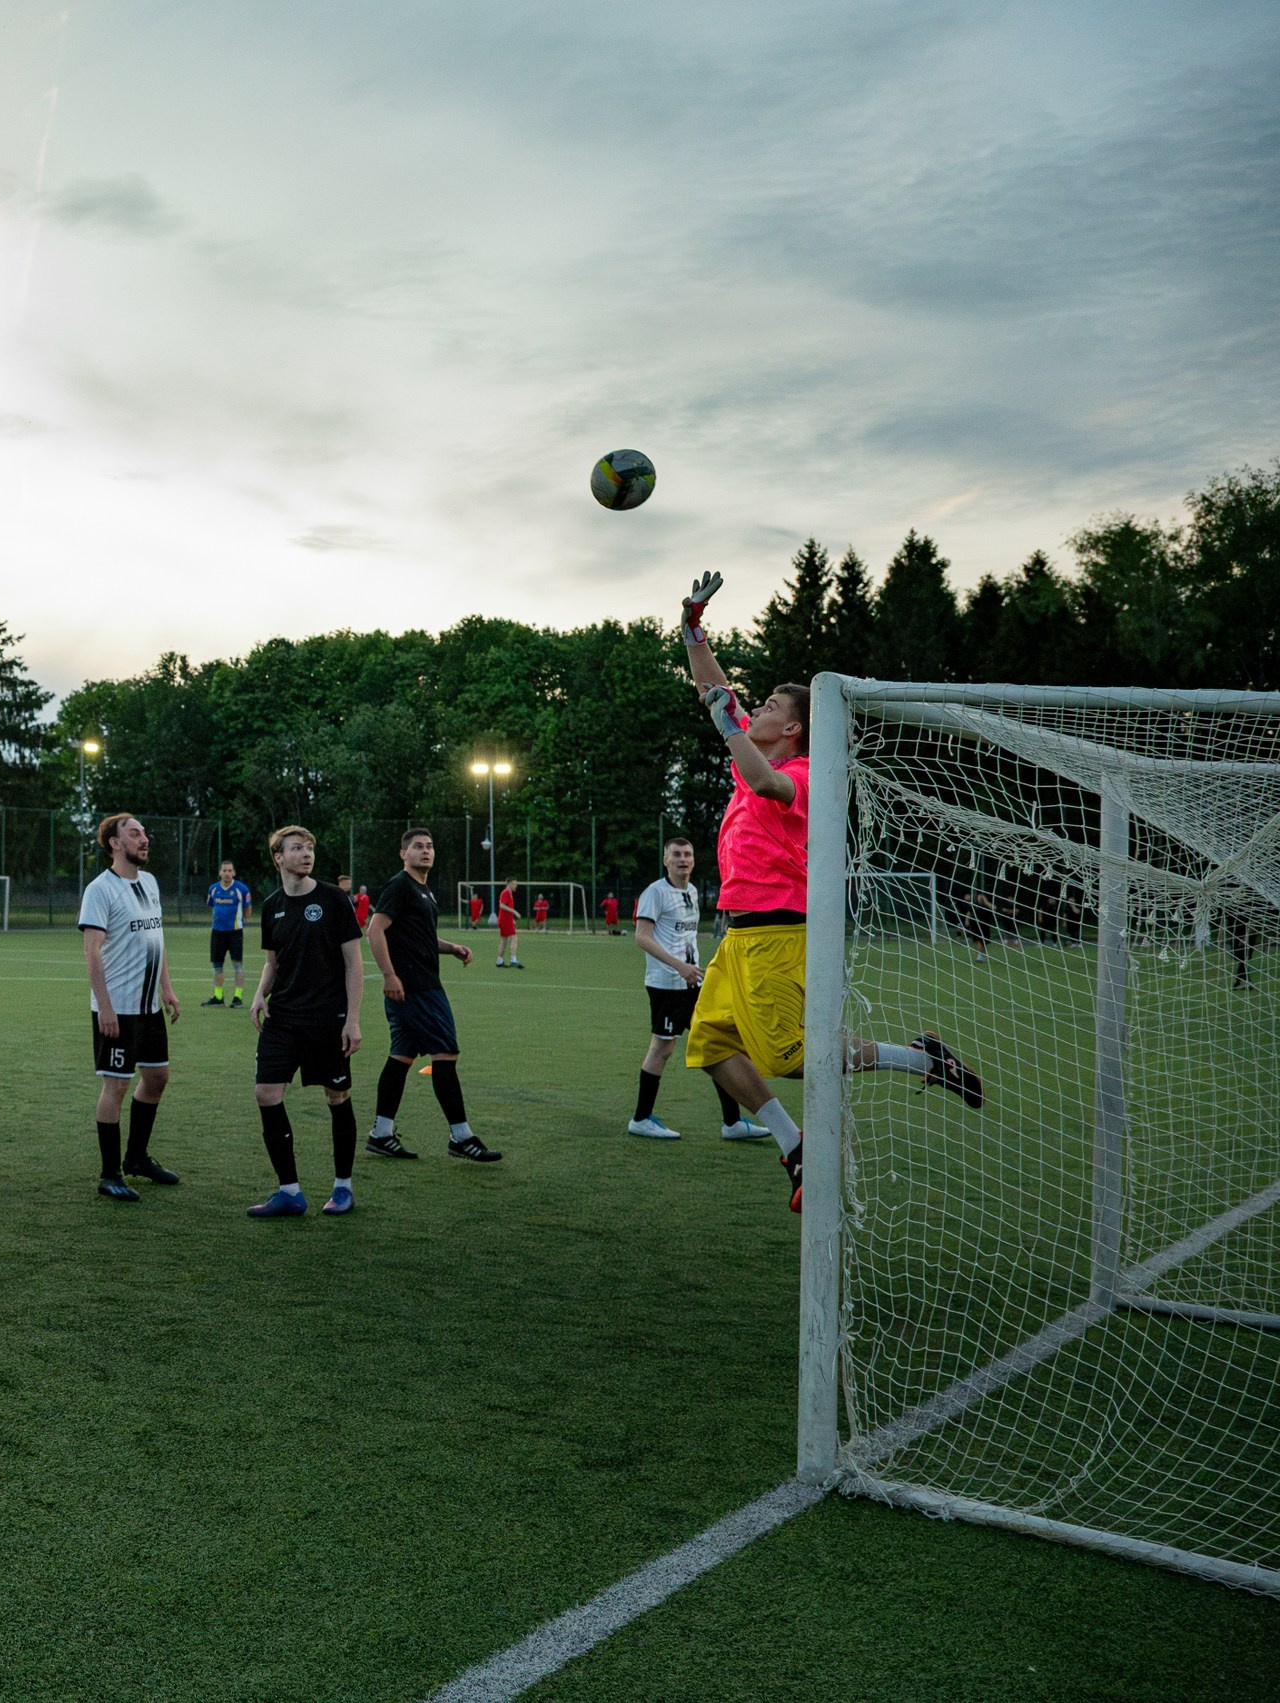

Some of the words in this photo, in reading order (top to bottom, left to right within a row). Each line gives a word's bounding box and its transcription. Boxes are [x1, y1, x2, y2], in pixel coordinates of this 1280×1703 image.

[130, 917, 163, 932] ЕРШОВ
[664, 1016, 673, 1033] 4
[110, 1047, 125, 1068] 15
